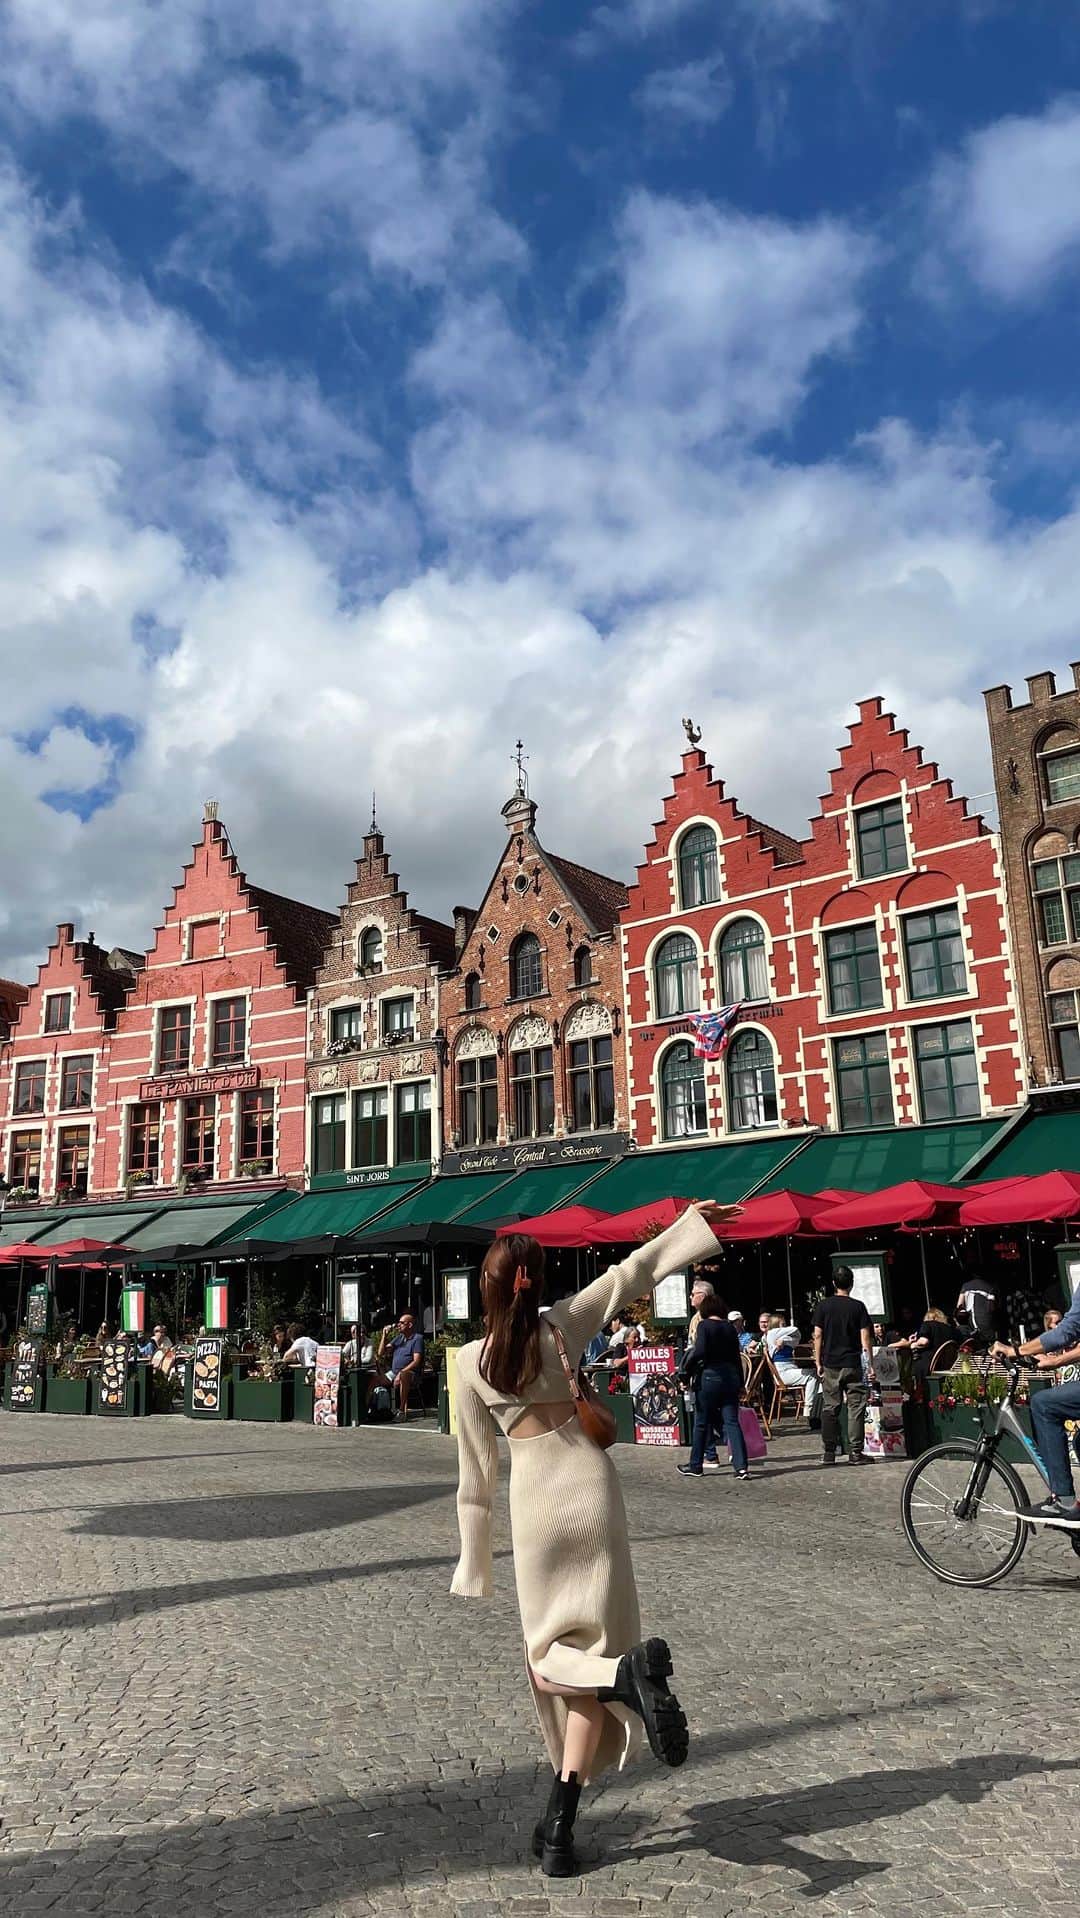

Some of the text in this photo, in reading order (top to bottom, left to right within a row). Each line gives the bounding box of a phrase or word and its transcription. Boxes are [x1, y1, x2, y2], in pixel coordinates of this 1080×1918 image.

[145, 1084, 162, 1098] LE
[164, 1076, 215, 1097] PANIER
[346, 1170, 390, 1184] SINT JORIS
[197, 1342, 217, 1359] PIZZA
[631, 1348, 670, 1360] MOULES
[635, 1361, 668, 1373] FRITES
[198, 1380, 218, 1389] PASTA
